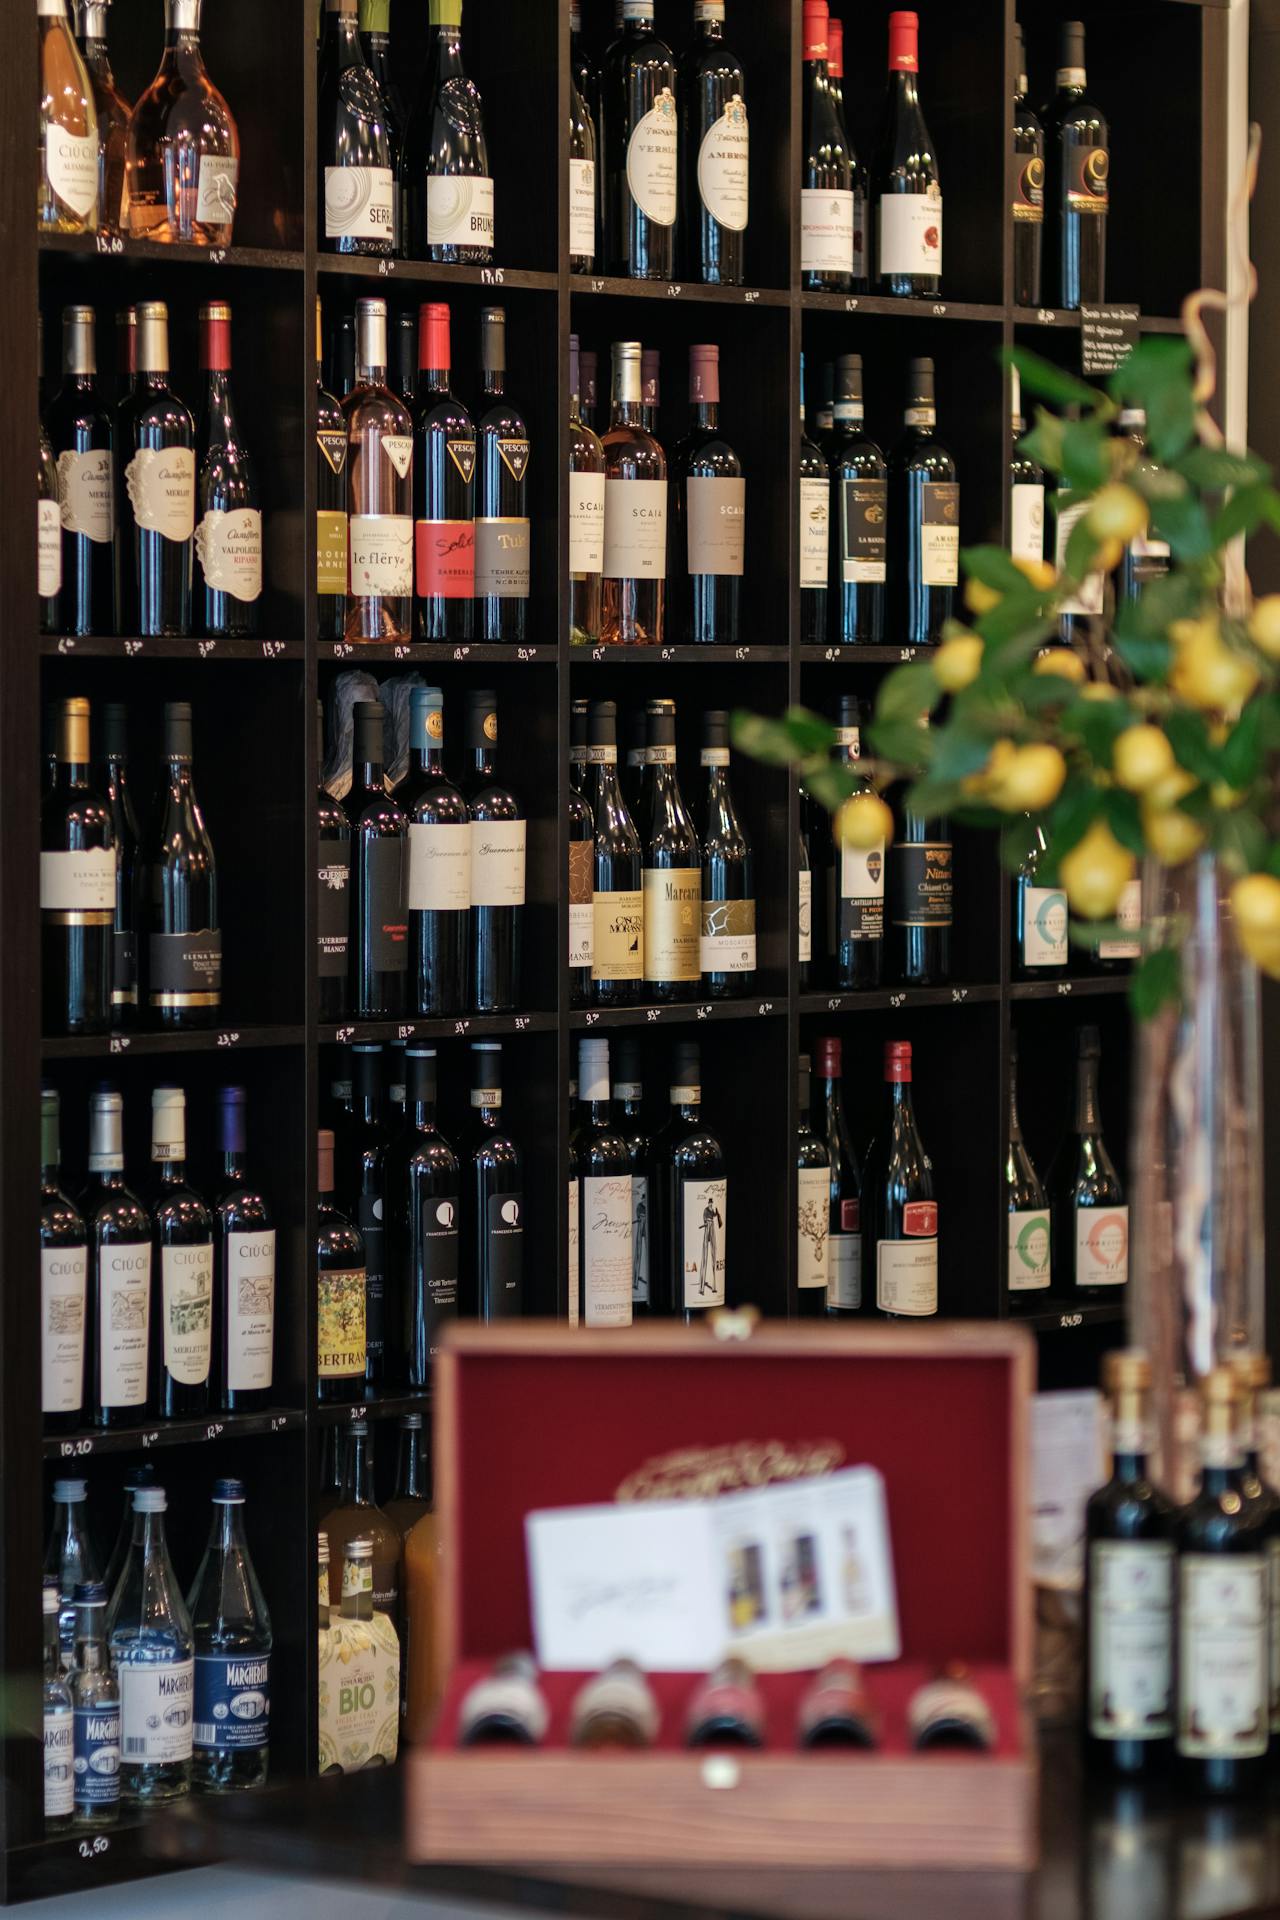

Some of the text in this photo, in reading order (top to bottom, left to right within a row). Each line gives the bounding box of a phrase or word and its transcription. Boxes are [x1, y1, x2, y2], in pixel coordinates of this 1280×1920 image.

[262, 640, 286, 658] 13,90
[239, 1244, 261, 1258] CIÙ
[686, 1261, 698, 1273] LA
[60, 1438, 93, 1457] 10,20
[338, 1683, 376, 1716] BIO
[78, 1836, 110, 1858] 2,50
